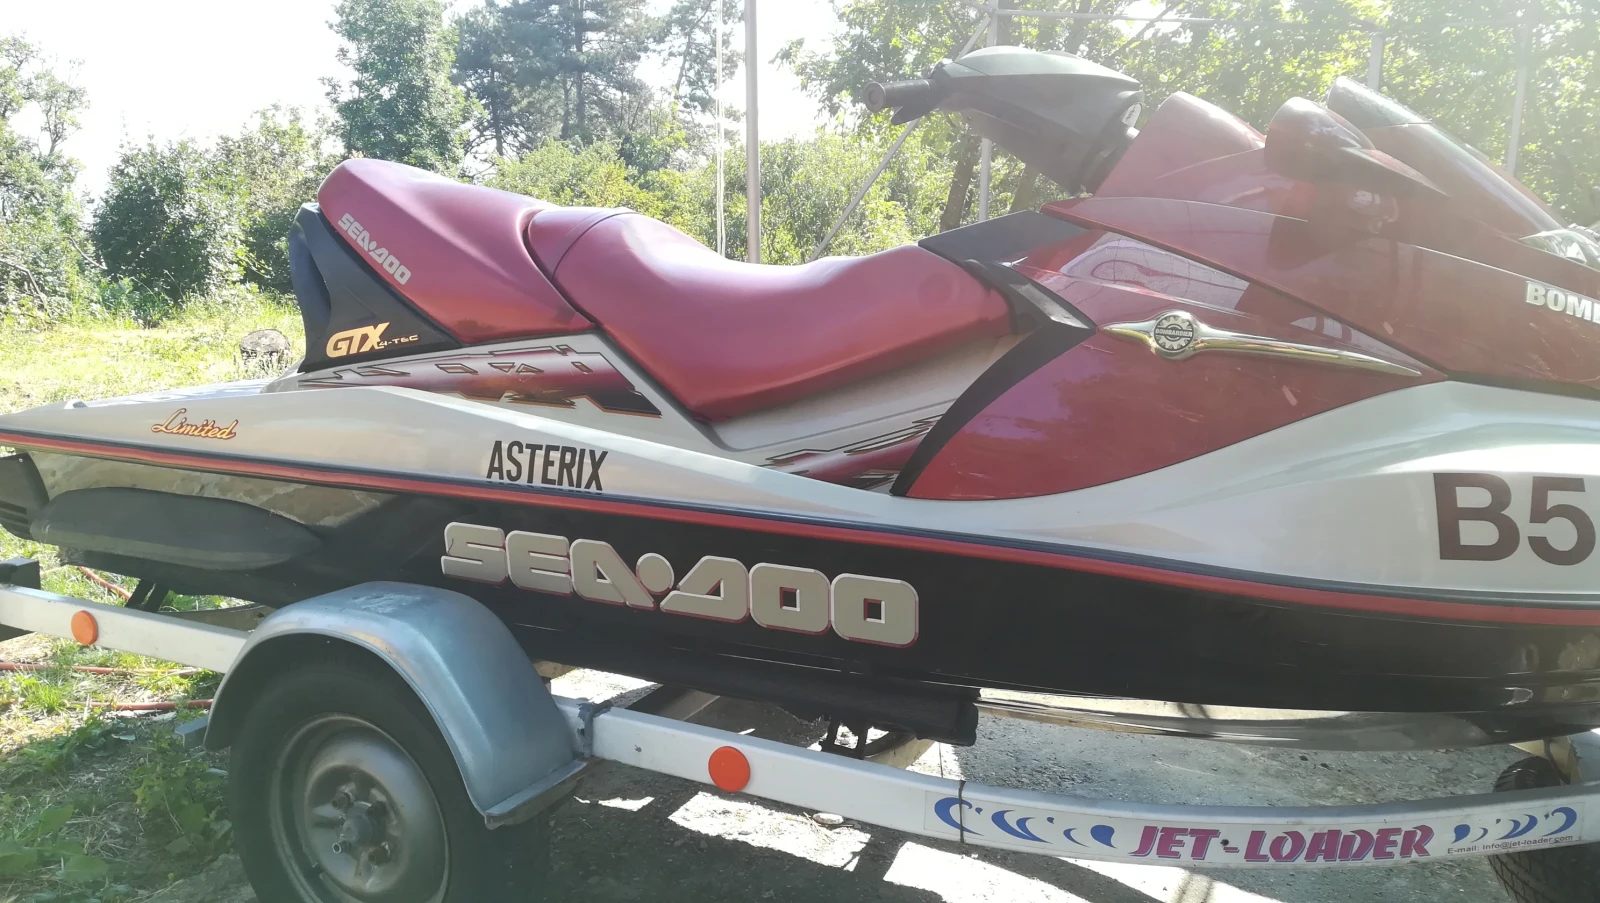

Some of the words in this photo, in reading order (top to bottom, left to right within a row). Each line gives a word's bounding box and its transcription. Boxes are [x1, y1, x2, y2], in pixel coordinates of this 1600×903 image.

[326, 322, 390, 358] GTX
[1155, 328, 1193, 337] BOMBARDIER
[151, 408, 239, 440] Limited
[486, 440, 608, 492] ASTERIX
[1433, 473, 1596, 566] B5
[1447, 844, 1480, 854] E-mail:
